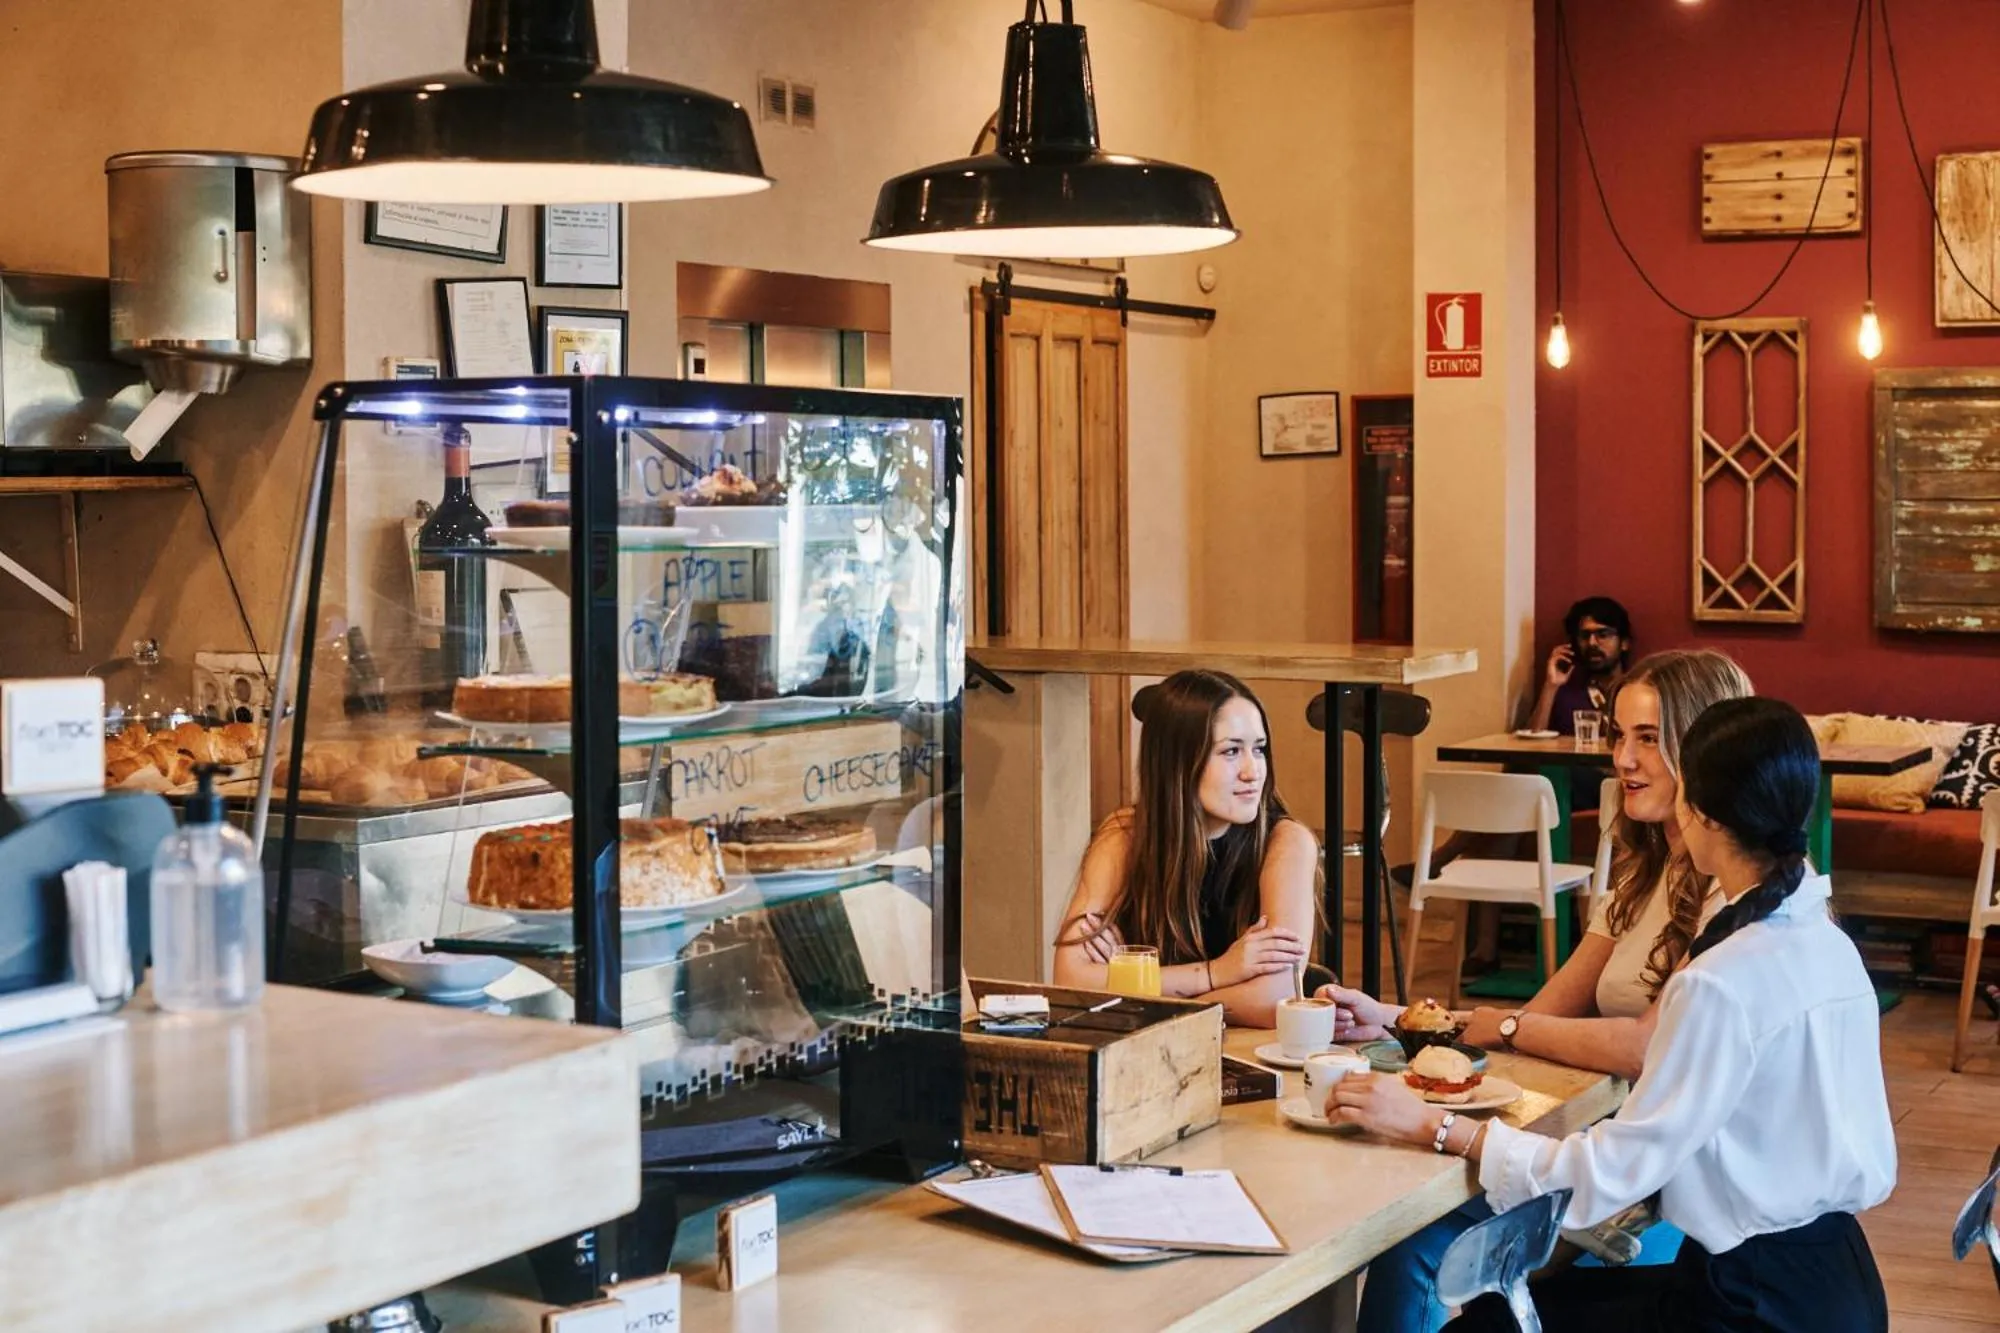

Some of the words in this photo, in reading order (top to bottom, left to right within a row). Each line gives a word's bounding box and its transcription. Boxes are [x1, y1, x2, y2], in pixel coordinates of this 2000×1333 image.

[1429, 358, 1480, 374] EXTINTOR
[663, 549, 748, 609] APPLE
[668, 742, 766, 801] CARROT
